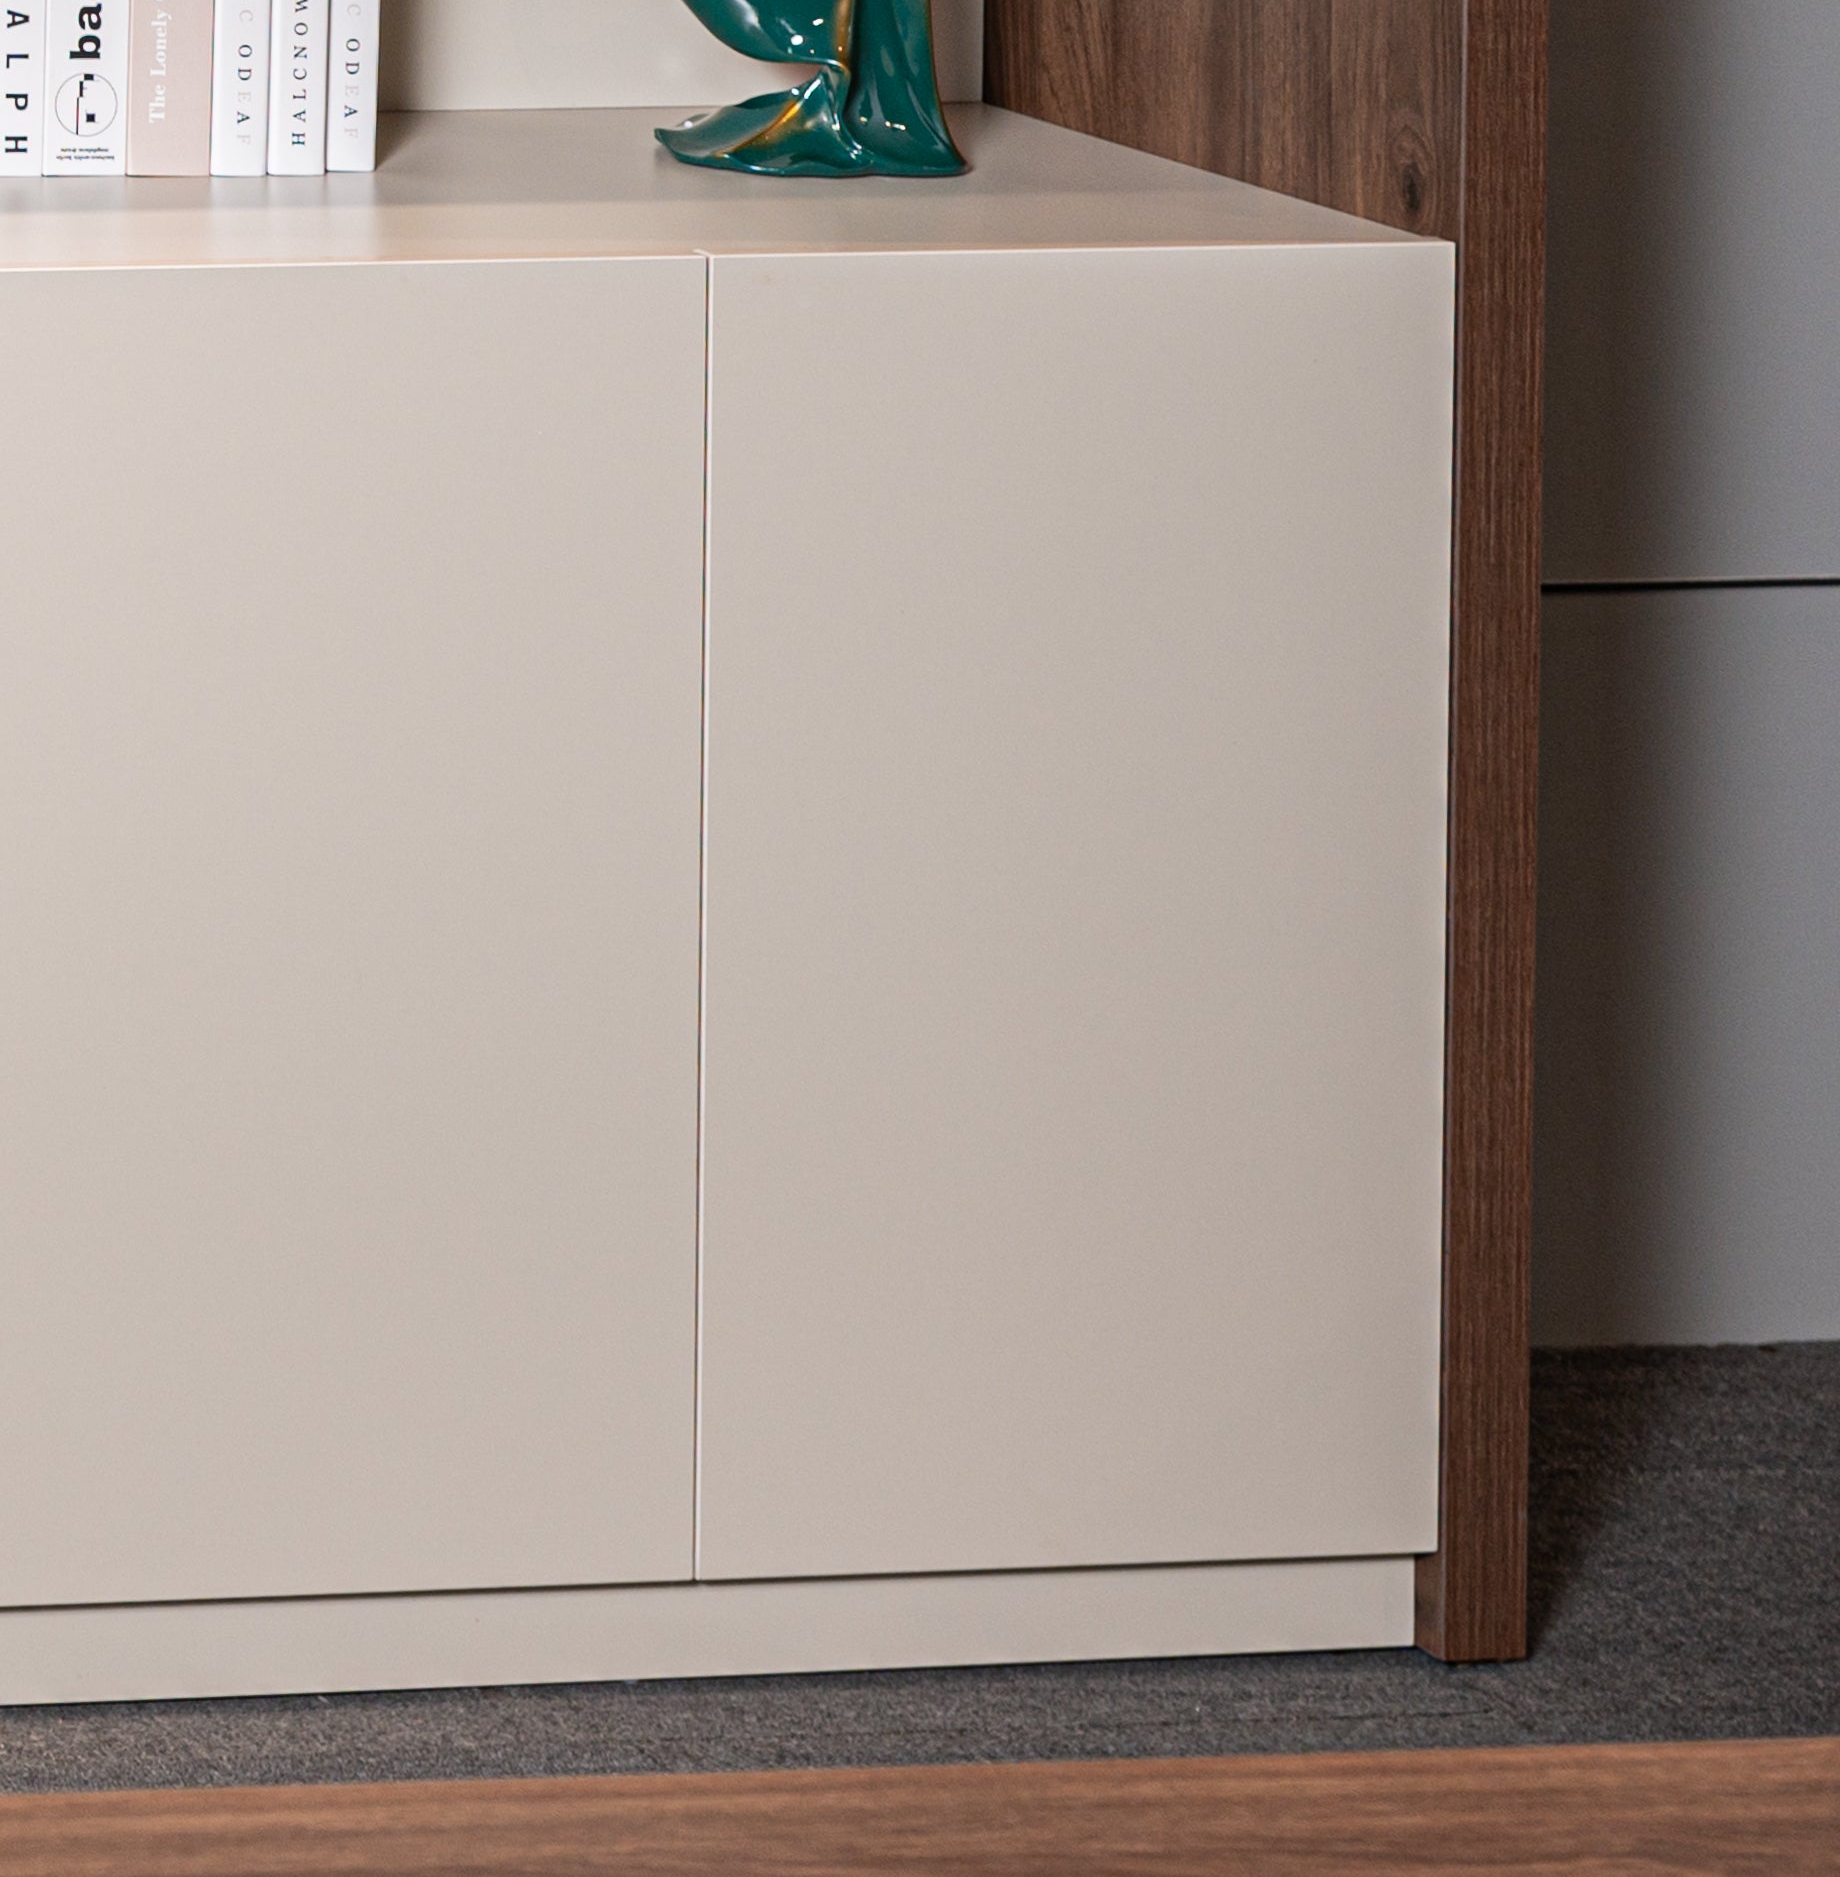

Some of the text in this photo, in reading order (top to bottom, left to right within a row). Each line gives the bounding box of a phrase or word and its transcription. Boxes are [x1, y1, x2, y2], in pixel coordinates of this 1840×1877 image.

[150, 9, 172, 76] Lonely
[4, 9, 30, 153] ALPH
[148, 85, 167, 124] The
